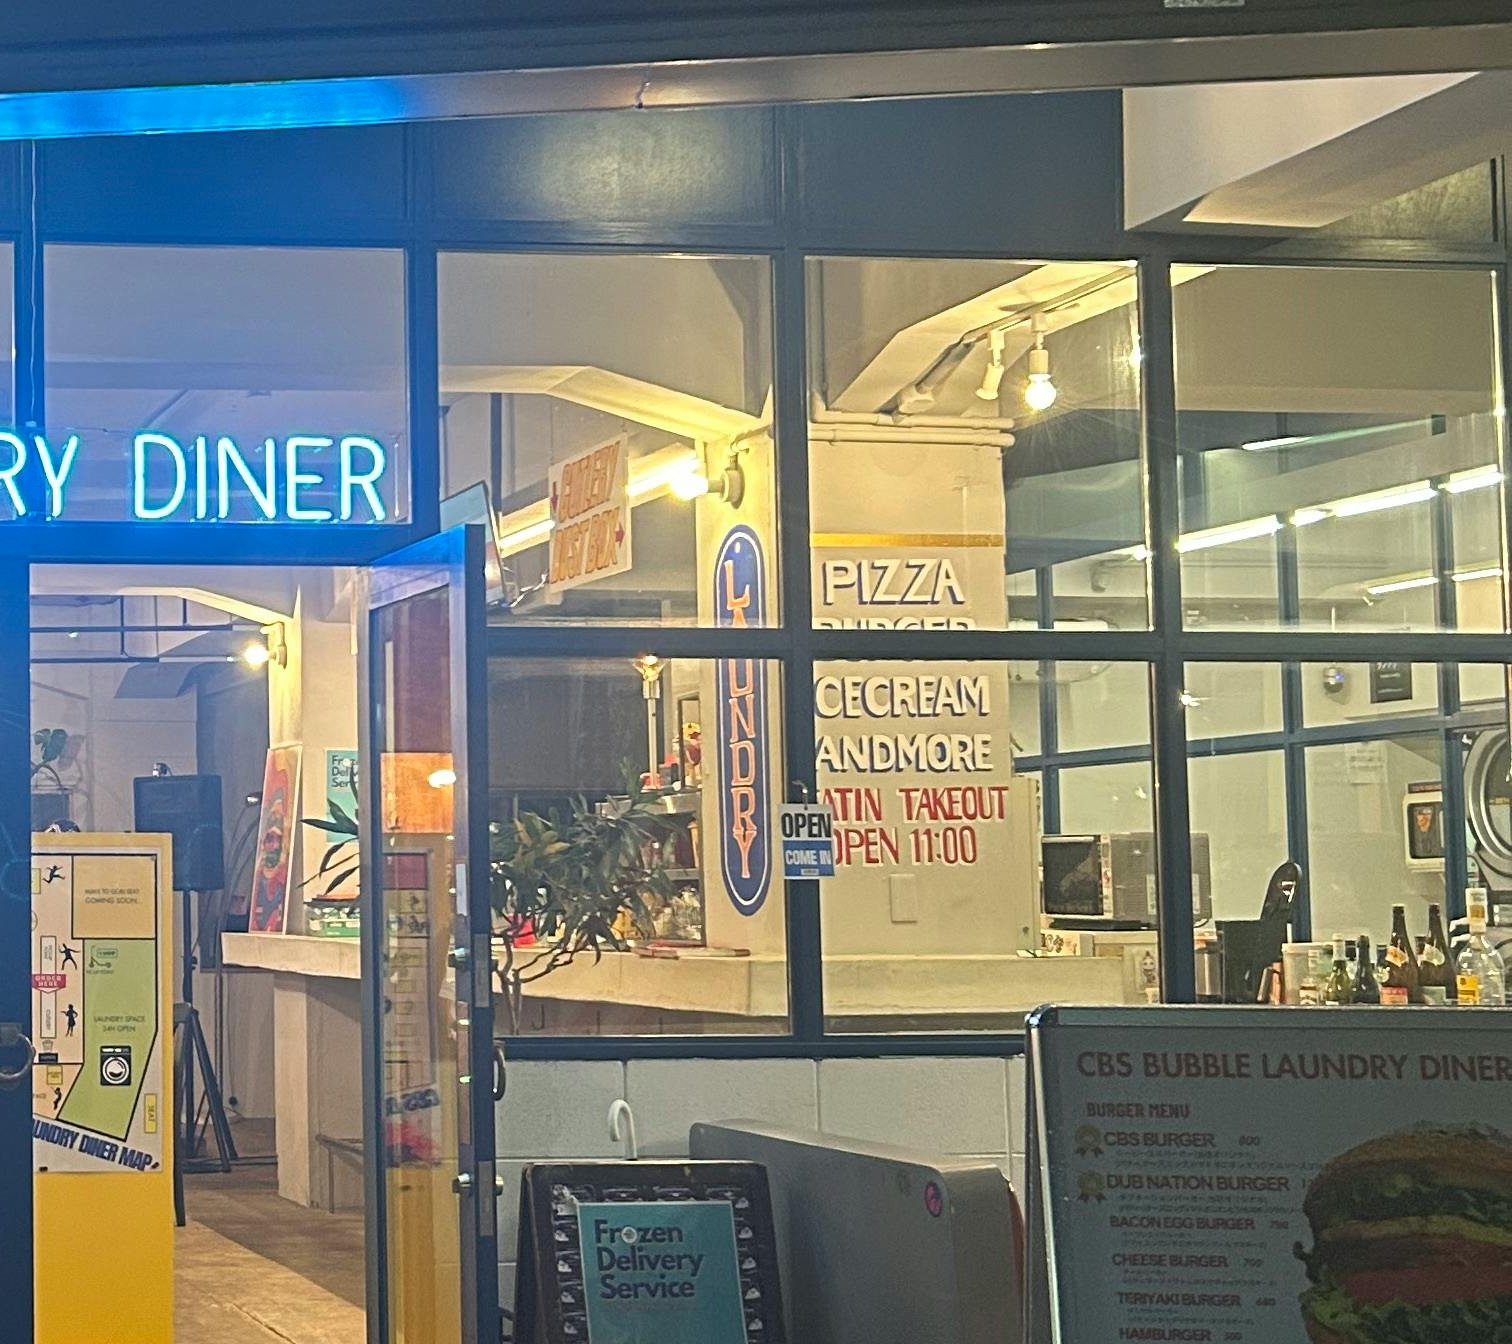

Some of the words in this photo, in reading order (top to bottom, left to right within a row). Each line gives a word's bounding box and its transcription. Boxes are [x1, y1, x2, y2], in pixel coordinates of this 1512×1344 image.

[133, 430, 389, 523] DINER
[822, 559, 965, 605] PIZZA
[816, 734, 994, 772] ANDMORE
[898, 786, 1008, 822] TAKEOUT
[781, 813, 831, 837] OPEN
[785, 850, 817, 864] COME
[819, 850, 831, 864] IN
[911, 825, 977, 865] 11:00
[1076, 1051, 1133, 1077] CBS
[1143, 1052, 1251, 1079] BUBBLE
[1262, 1053, 1409, 1080] LAUNDRY
[1419, 1055, 1512, 1082] DINER
[1087, 1103, 1145, 1117] BURGER
[1148, 1104, 1190, 1119] MENU
[79, 1131, 118, 1160] DINER
[119, 1146, 152, 1171] MAP
[1103, 1131, 1139, 1146] CBS
[1143, 1132, 1216, 1147] BURGER
[1106, 1174, 1143, 1189] DUB
[1146, 1175, 1213, 1190] NATION
[1216, 1176, 1290, 1191] BURGER
[594, 1219, 683, 1244] Frzen
[1110, 1216, 1160, 1229] BACON
[1163, 1216, 1194, 1229] EGG
[1196, 1217, 1256, 1230] BURGER
[596, 1246, 705, 1277] Delivery
[1112, 1253, 1167, 1267] CHEESE
[1170, 1254, 1229, 1268] BURGER
[599, 1273, 696, 1299] Service
[1117, 1291, 1180, 1305] TERIYAKI
[1183, 1294, 1241, 1307] BURGER
[1119, 1327, 1212, 1342] HAMBURGER
